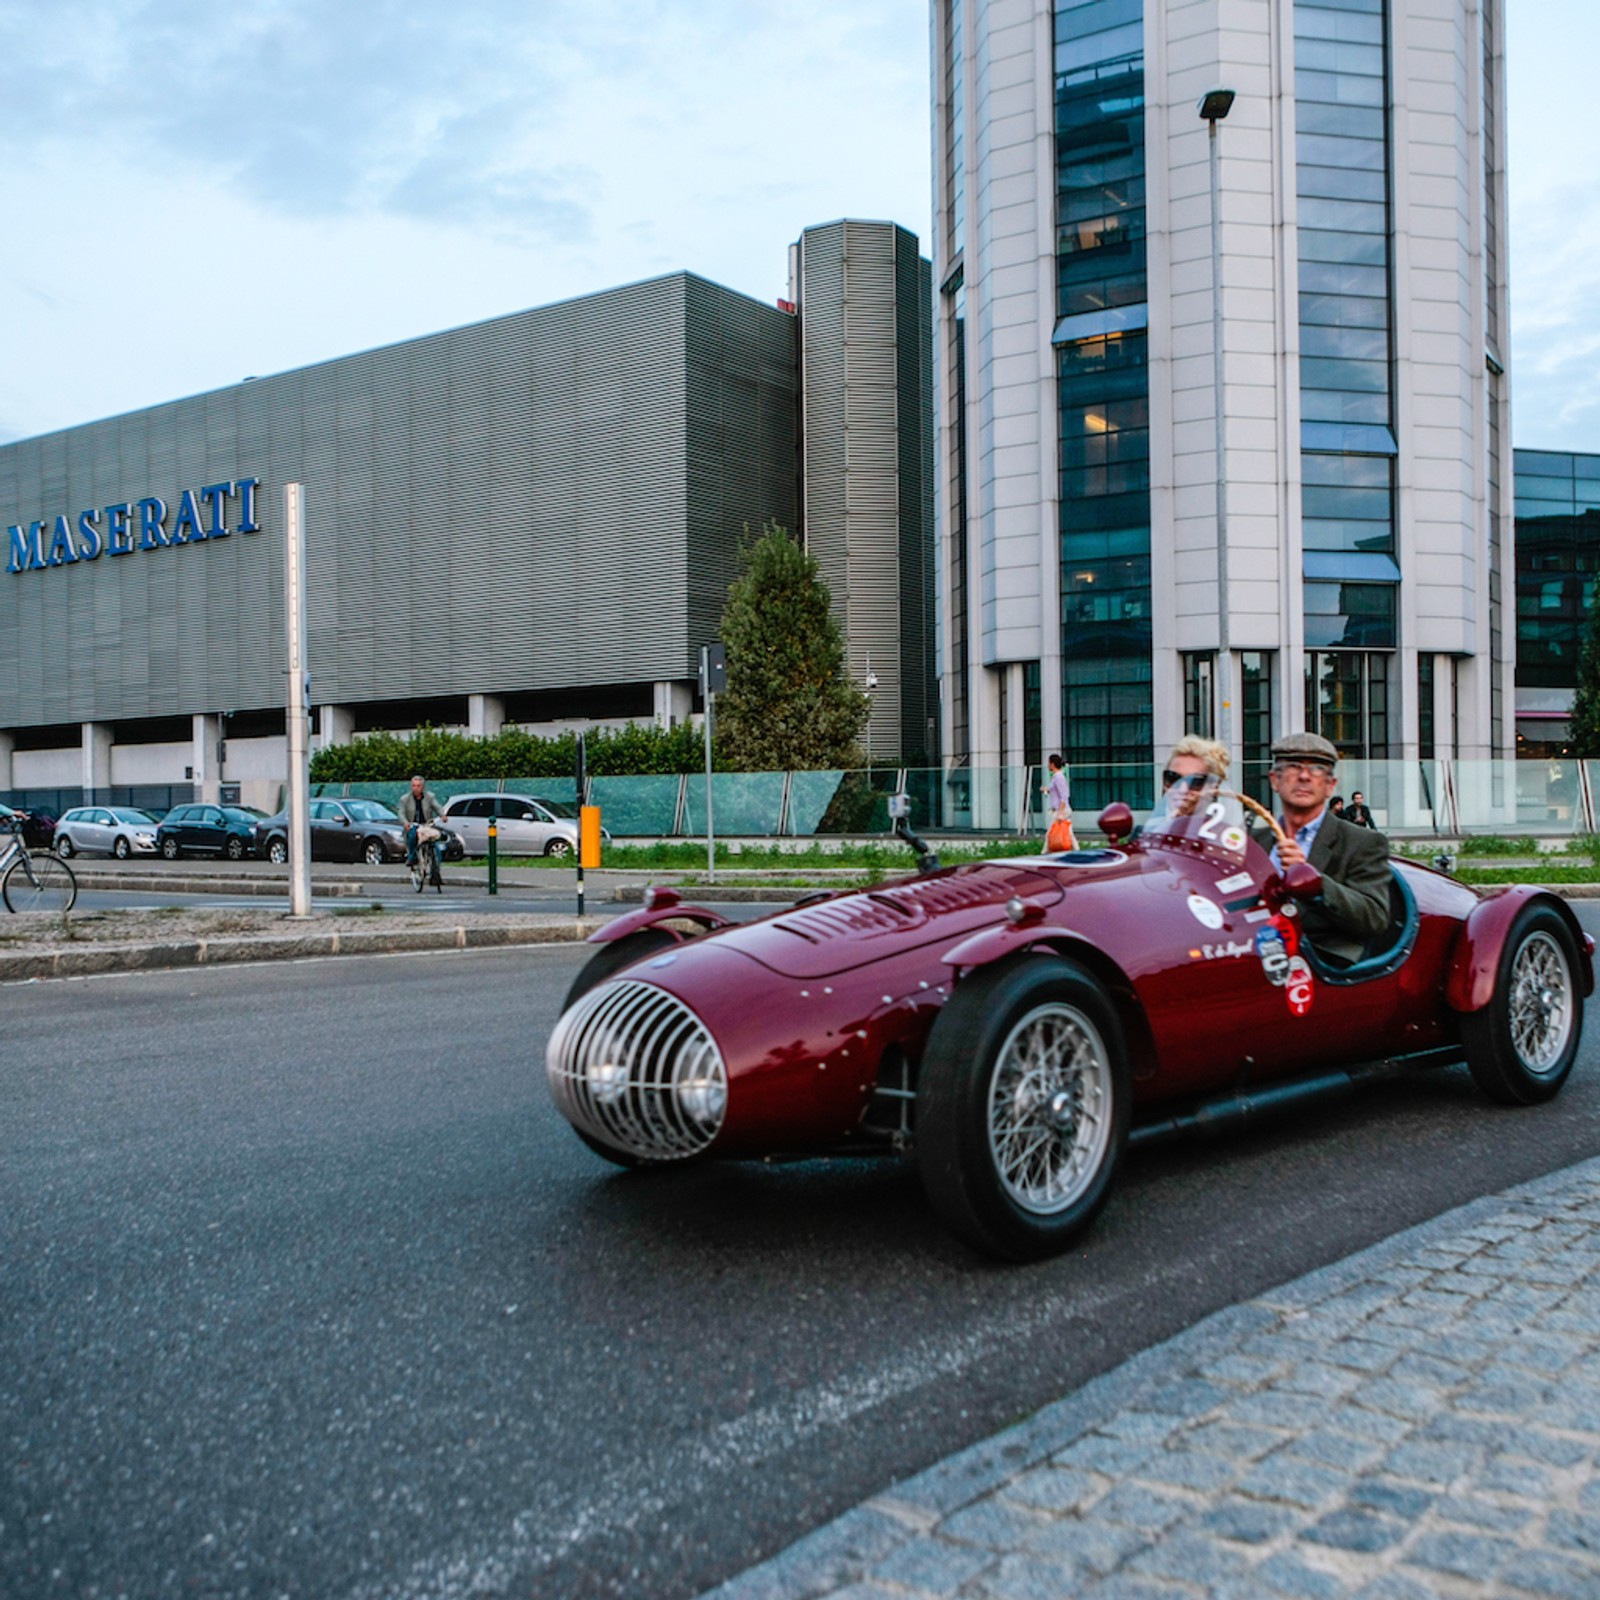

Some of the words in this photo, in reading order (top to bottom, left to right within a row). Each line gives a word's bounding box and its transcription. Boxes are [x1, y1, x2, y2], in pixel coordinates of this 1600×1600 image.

[6, 477, 260, 573] MASERATI
[1197, 802, 1225, 841] 2
[1288, 983, 1311, 1004] C
